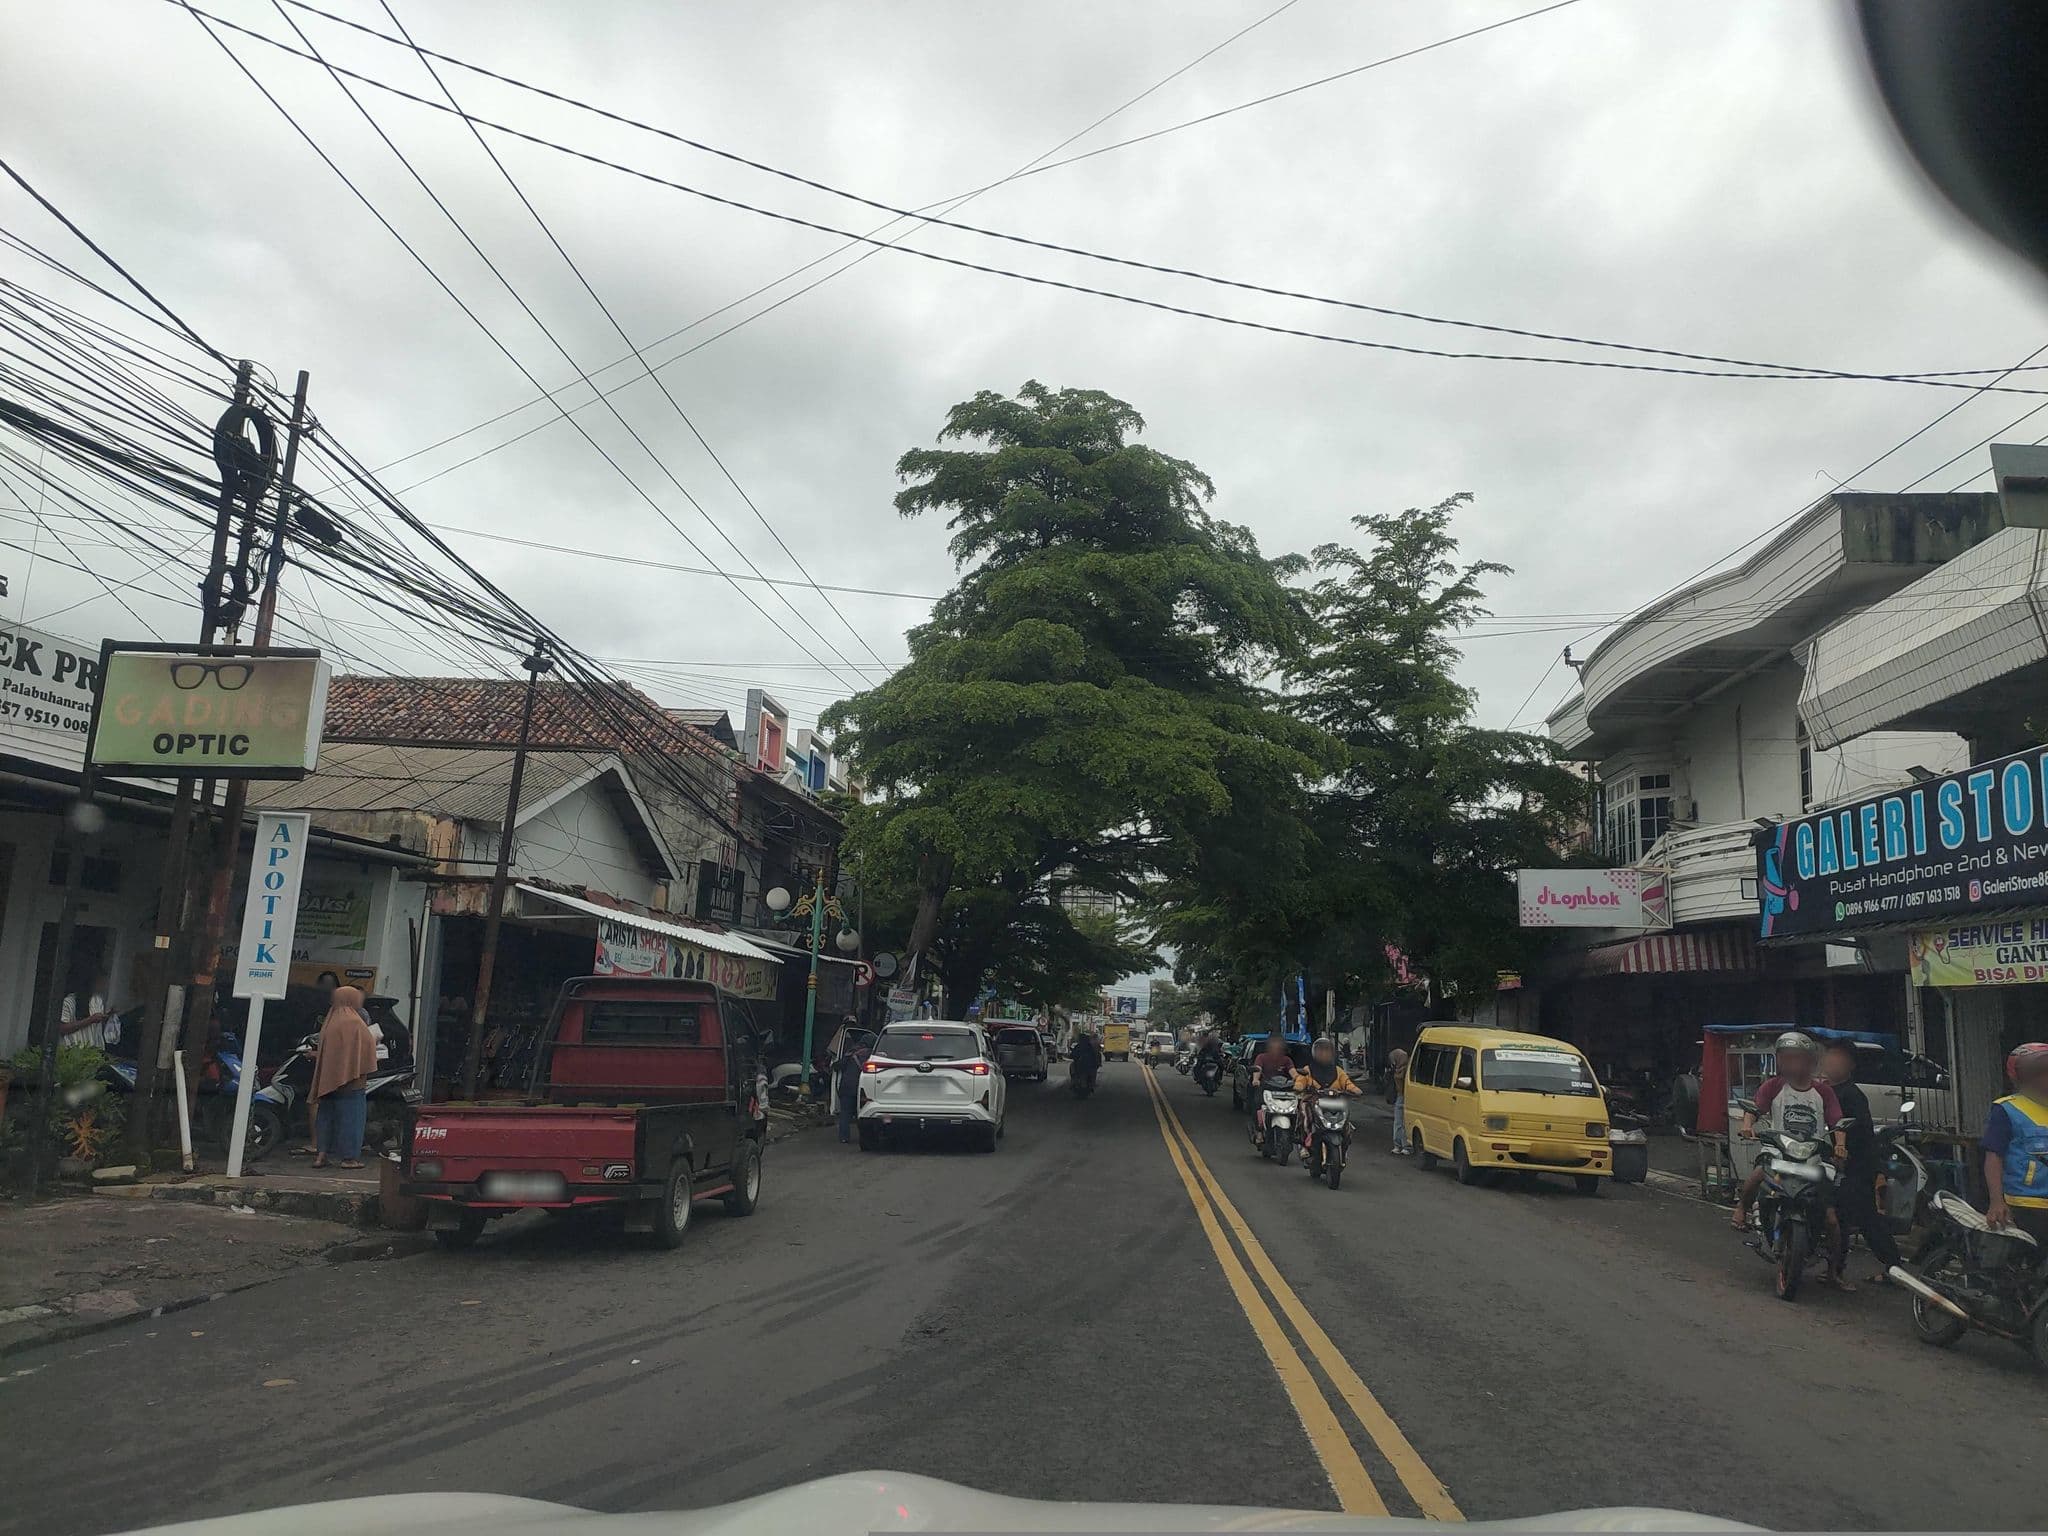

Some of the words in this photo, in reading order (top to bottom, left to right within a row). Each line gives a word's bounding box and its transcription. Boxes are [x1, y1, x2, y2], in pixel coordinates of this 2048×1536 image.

[2, 678, 92, 713] Palabuhanrat
[115, 693, 299, 728] GADING
[24, 707, 60, 728] 9519
[63, 717, 89, 733] 008
[153, 733, 250, 755] OPTIC
[1796, 790, 1926, 880] GALERI
[1830, 876, 1867, 895] Pusat
[1870, 863, 1953, 888] Handphone
[1958, 849, 1991, 872] 2nd
[1996, 847, 2008, 865] &
[255, 823, 292, 964] APOTIK
[1845, 902, 1863, 916] 0896
[1864, 900, 1880, 913] 9166
[1905, 892, 1925, 907] 0857
[1926, 888, 1942, 904] 1613
[1944, 886, 1961, 901] 1518
[600, 920, 637, 950] LARISTA
[640, 931, 667, 952] SHOES
[1948, 921, 2023, 948] SERVICE
[2031, 918, 2048, 941] H
[248, 970, 273, 979] PRIMA
[1974, 966, 2016, 982] BISA
